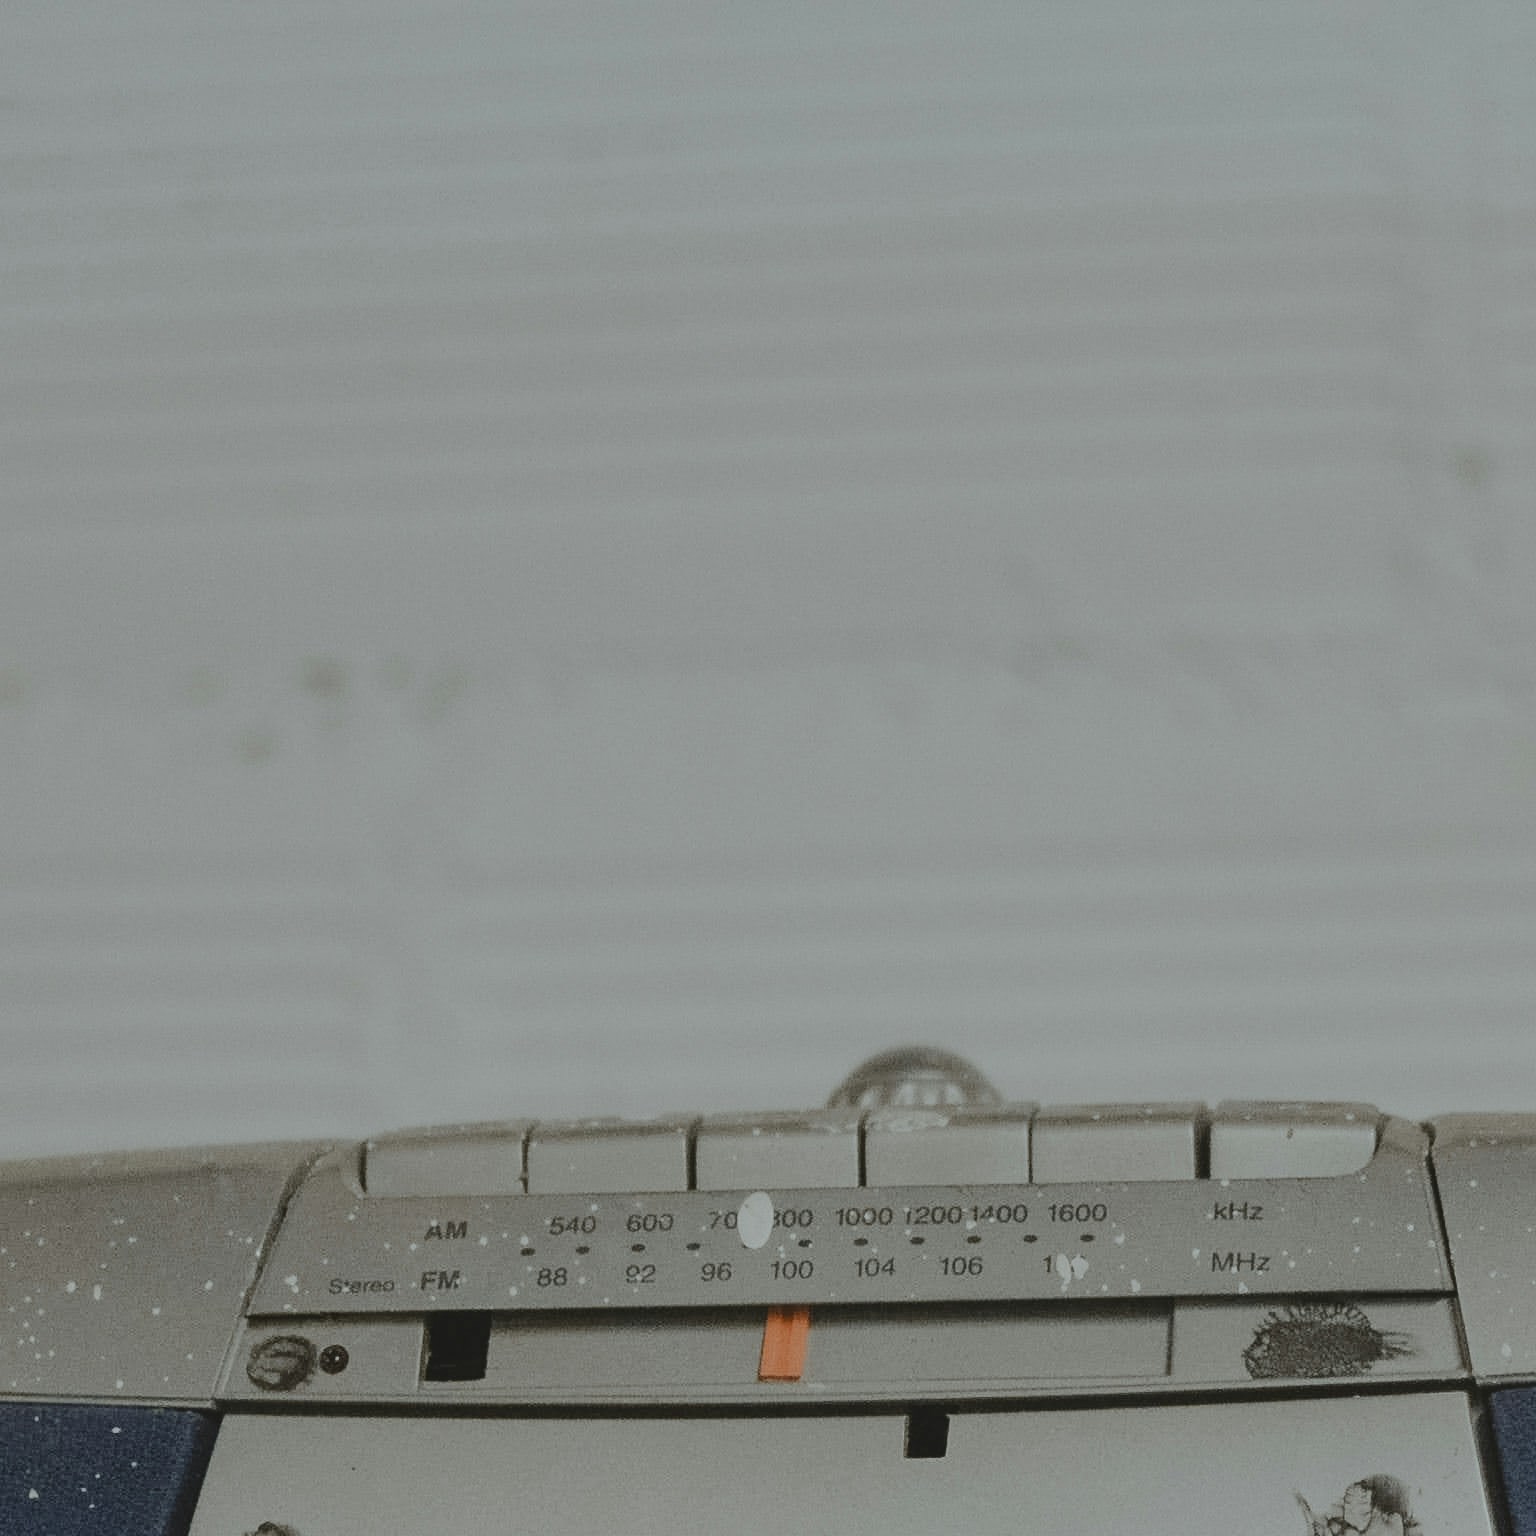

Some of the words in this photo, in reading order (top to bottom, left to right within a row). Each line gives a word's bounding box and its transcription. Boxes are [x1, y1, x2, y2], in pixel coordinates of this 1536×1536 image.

[424, 1221, 468, 1241] AM
[549, 1215, 596, 1235] 540
[626, 1213, 674, 1233] 600
[835, 1207, 893, 1226] 1000
[904, 1205, 962, 1226] 1200
[970, 1204, 1028, 1224] 1400
[1048, 1202, 1108, 1222] 1600
[1214, 1201, 1265, 1221] kHz
[328, 1277, 395, 1295] Stereo
[421, 1269, 461, 1291] FM
[536, 1266, 569, 1287] 88
[625, 1263, 657, 1284] 92
[700, 1261, 733, 1282] 96
[770, 1259, 814, 1280] 100
[854, 1256, 895, 1277] 104
[939, 1255, 984, 1276] 106
[1211, 1252, 1271, 1273] MHz
